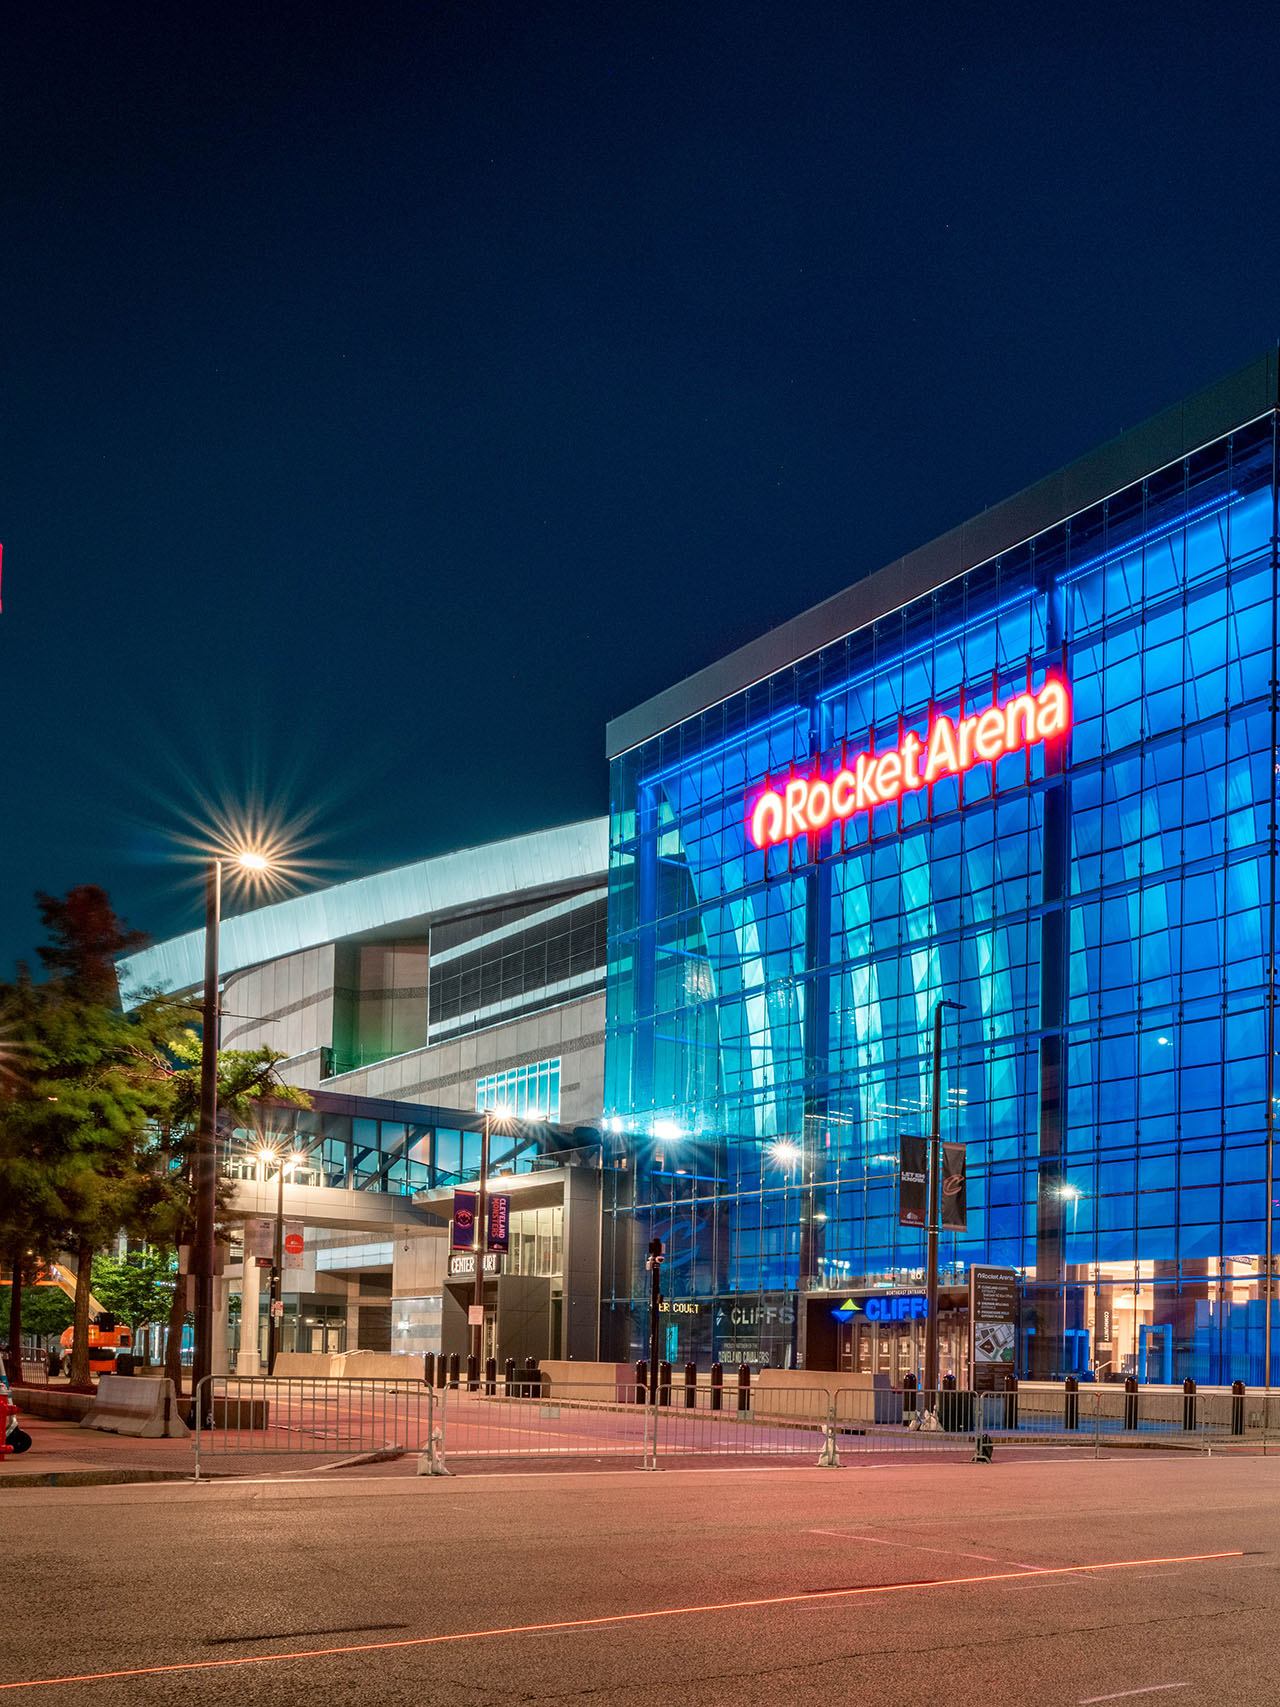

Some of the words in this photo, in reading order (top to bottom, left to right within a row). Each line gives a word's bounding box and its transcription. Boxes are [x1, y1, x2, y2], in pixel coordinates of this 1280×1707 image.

[785, 731, 920, 836] Rocket
[925, 681, 1067, 781] Arena
[491, 1197, 500, 1238] MONSTERS
[499, 1197, 507, 1239] CLEVELAND
[451, 1255, 475, 1273] CENTER
[672, 1303, 699, 1314] COURT
[731, 1306, 796, 1325] CLIFFS
